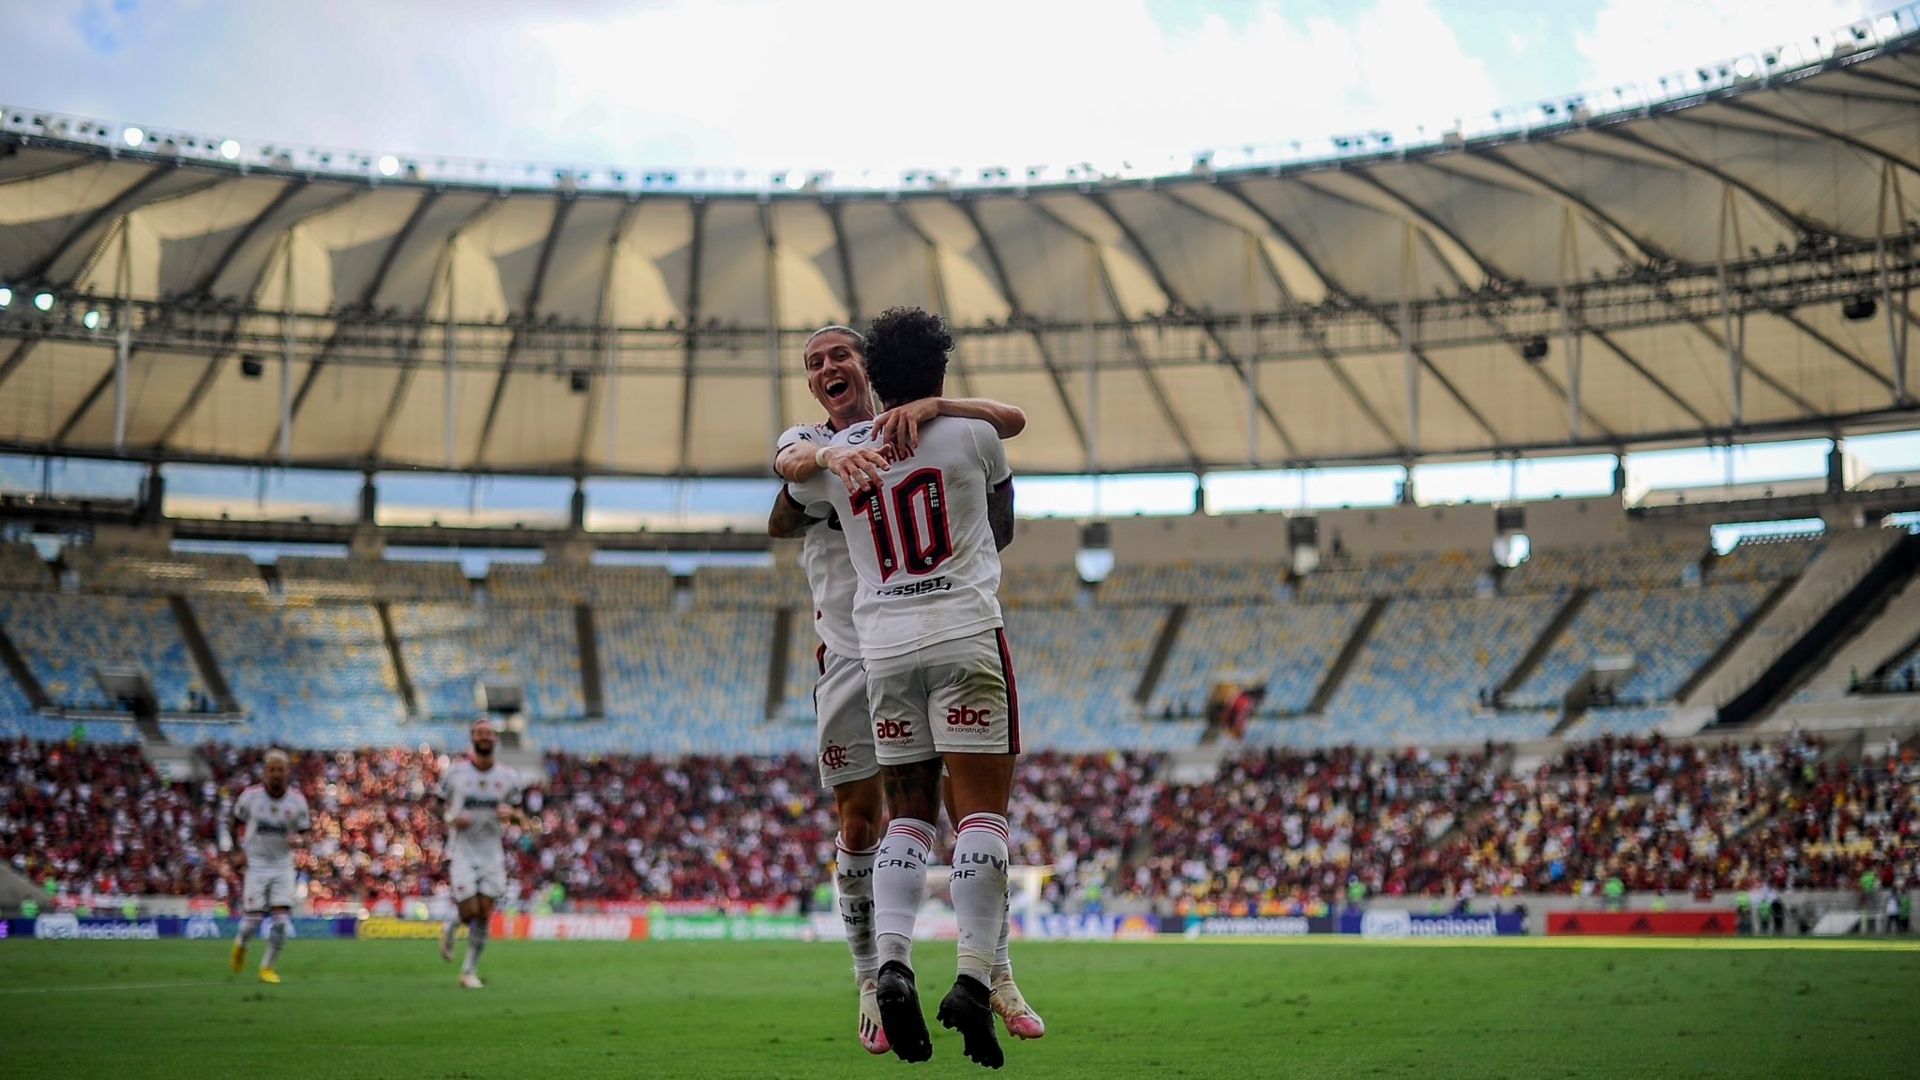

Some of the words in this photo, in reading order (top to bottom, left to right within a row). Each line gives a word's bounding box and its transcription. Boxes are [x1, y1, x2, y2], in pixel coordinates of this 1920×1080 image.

[849, 467, 953, 581] 10
[947, 705, 991, 727] abc
[876, 719, 913, 739] abc
[878, 859, 917, 870] CRF
